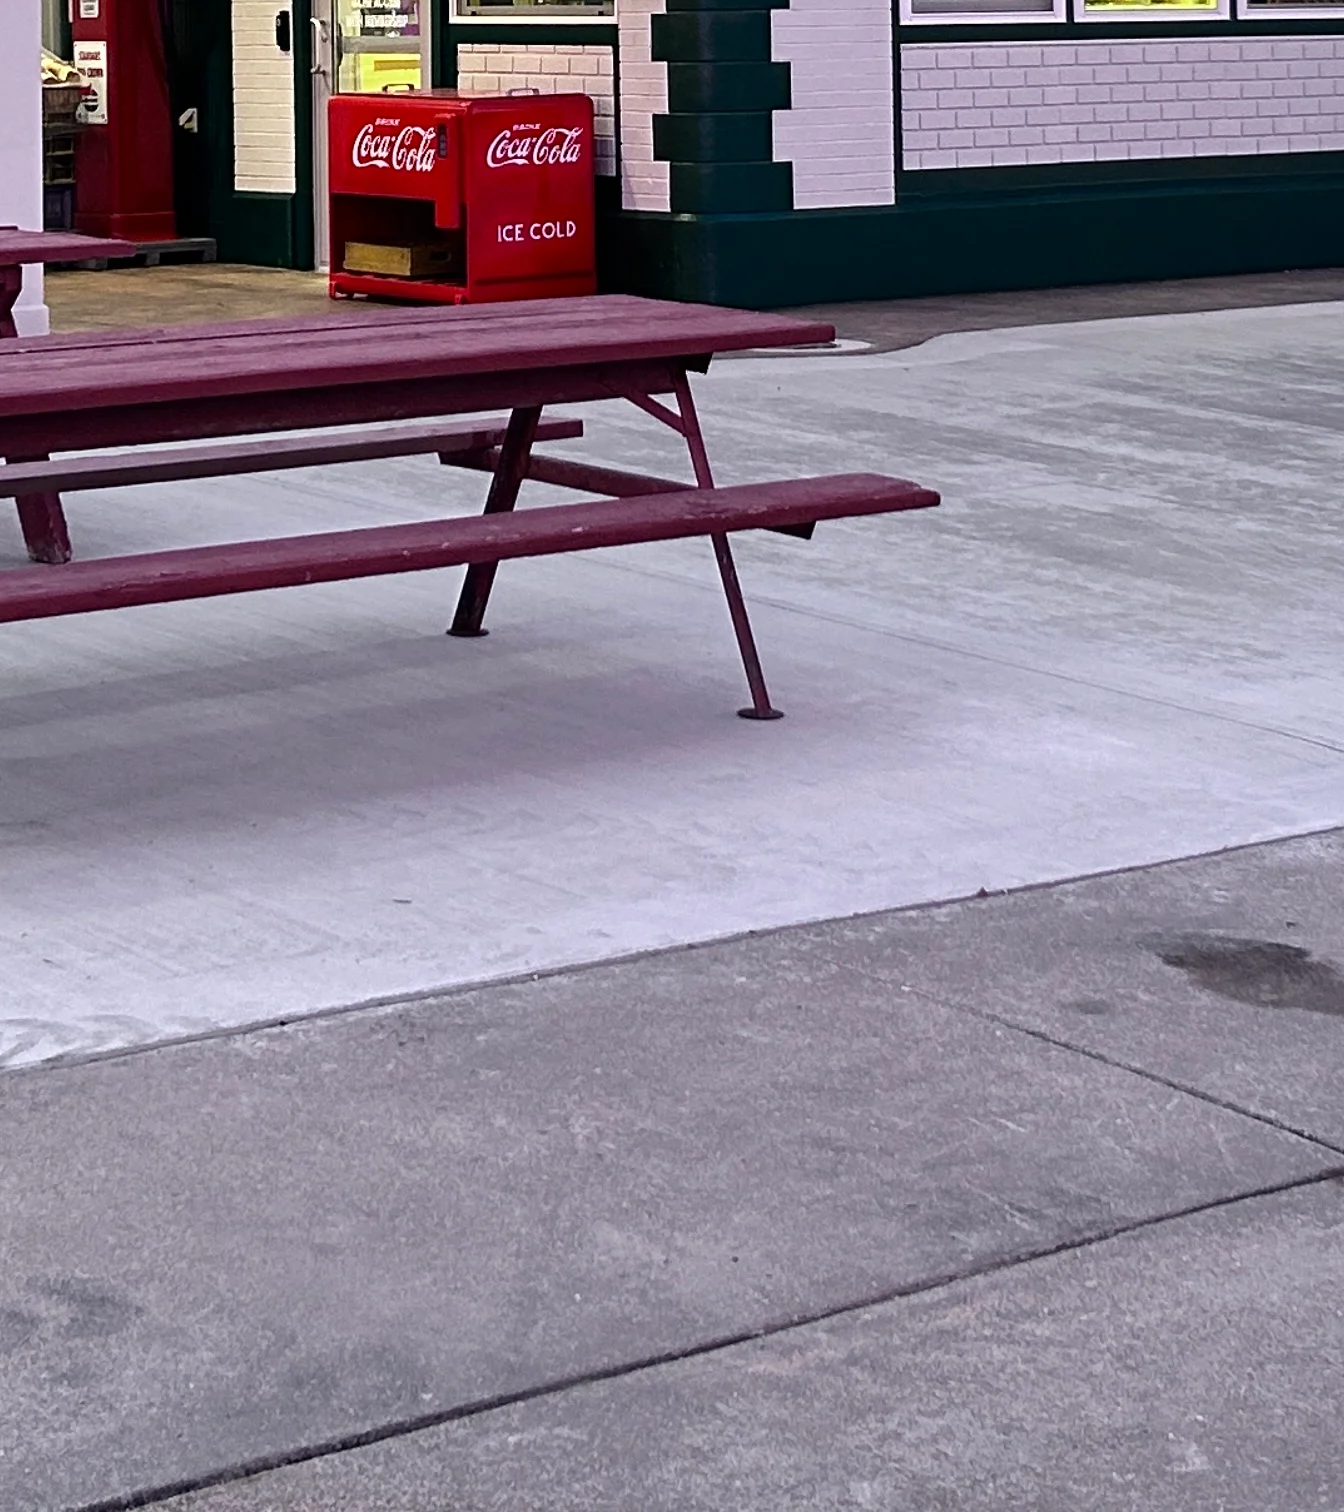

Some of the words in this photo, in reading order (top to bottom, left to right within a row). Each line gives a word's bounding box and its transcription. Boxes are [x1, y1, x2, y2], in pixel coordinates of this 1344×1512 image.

[352, 124, 436, 172] Coca-Cola
[486, 127, 584, 168] Coca-Cola
[497, 223, 525, 242] ICE
[529, 221, 577, 240] COLD
